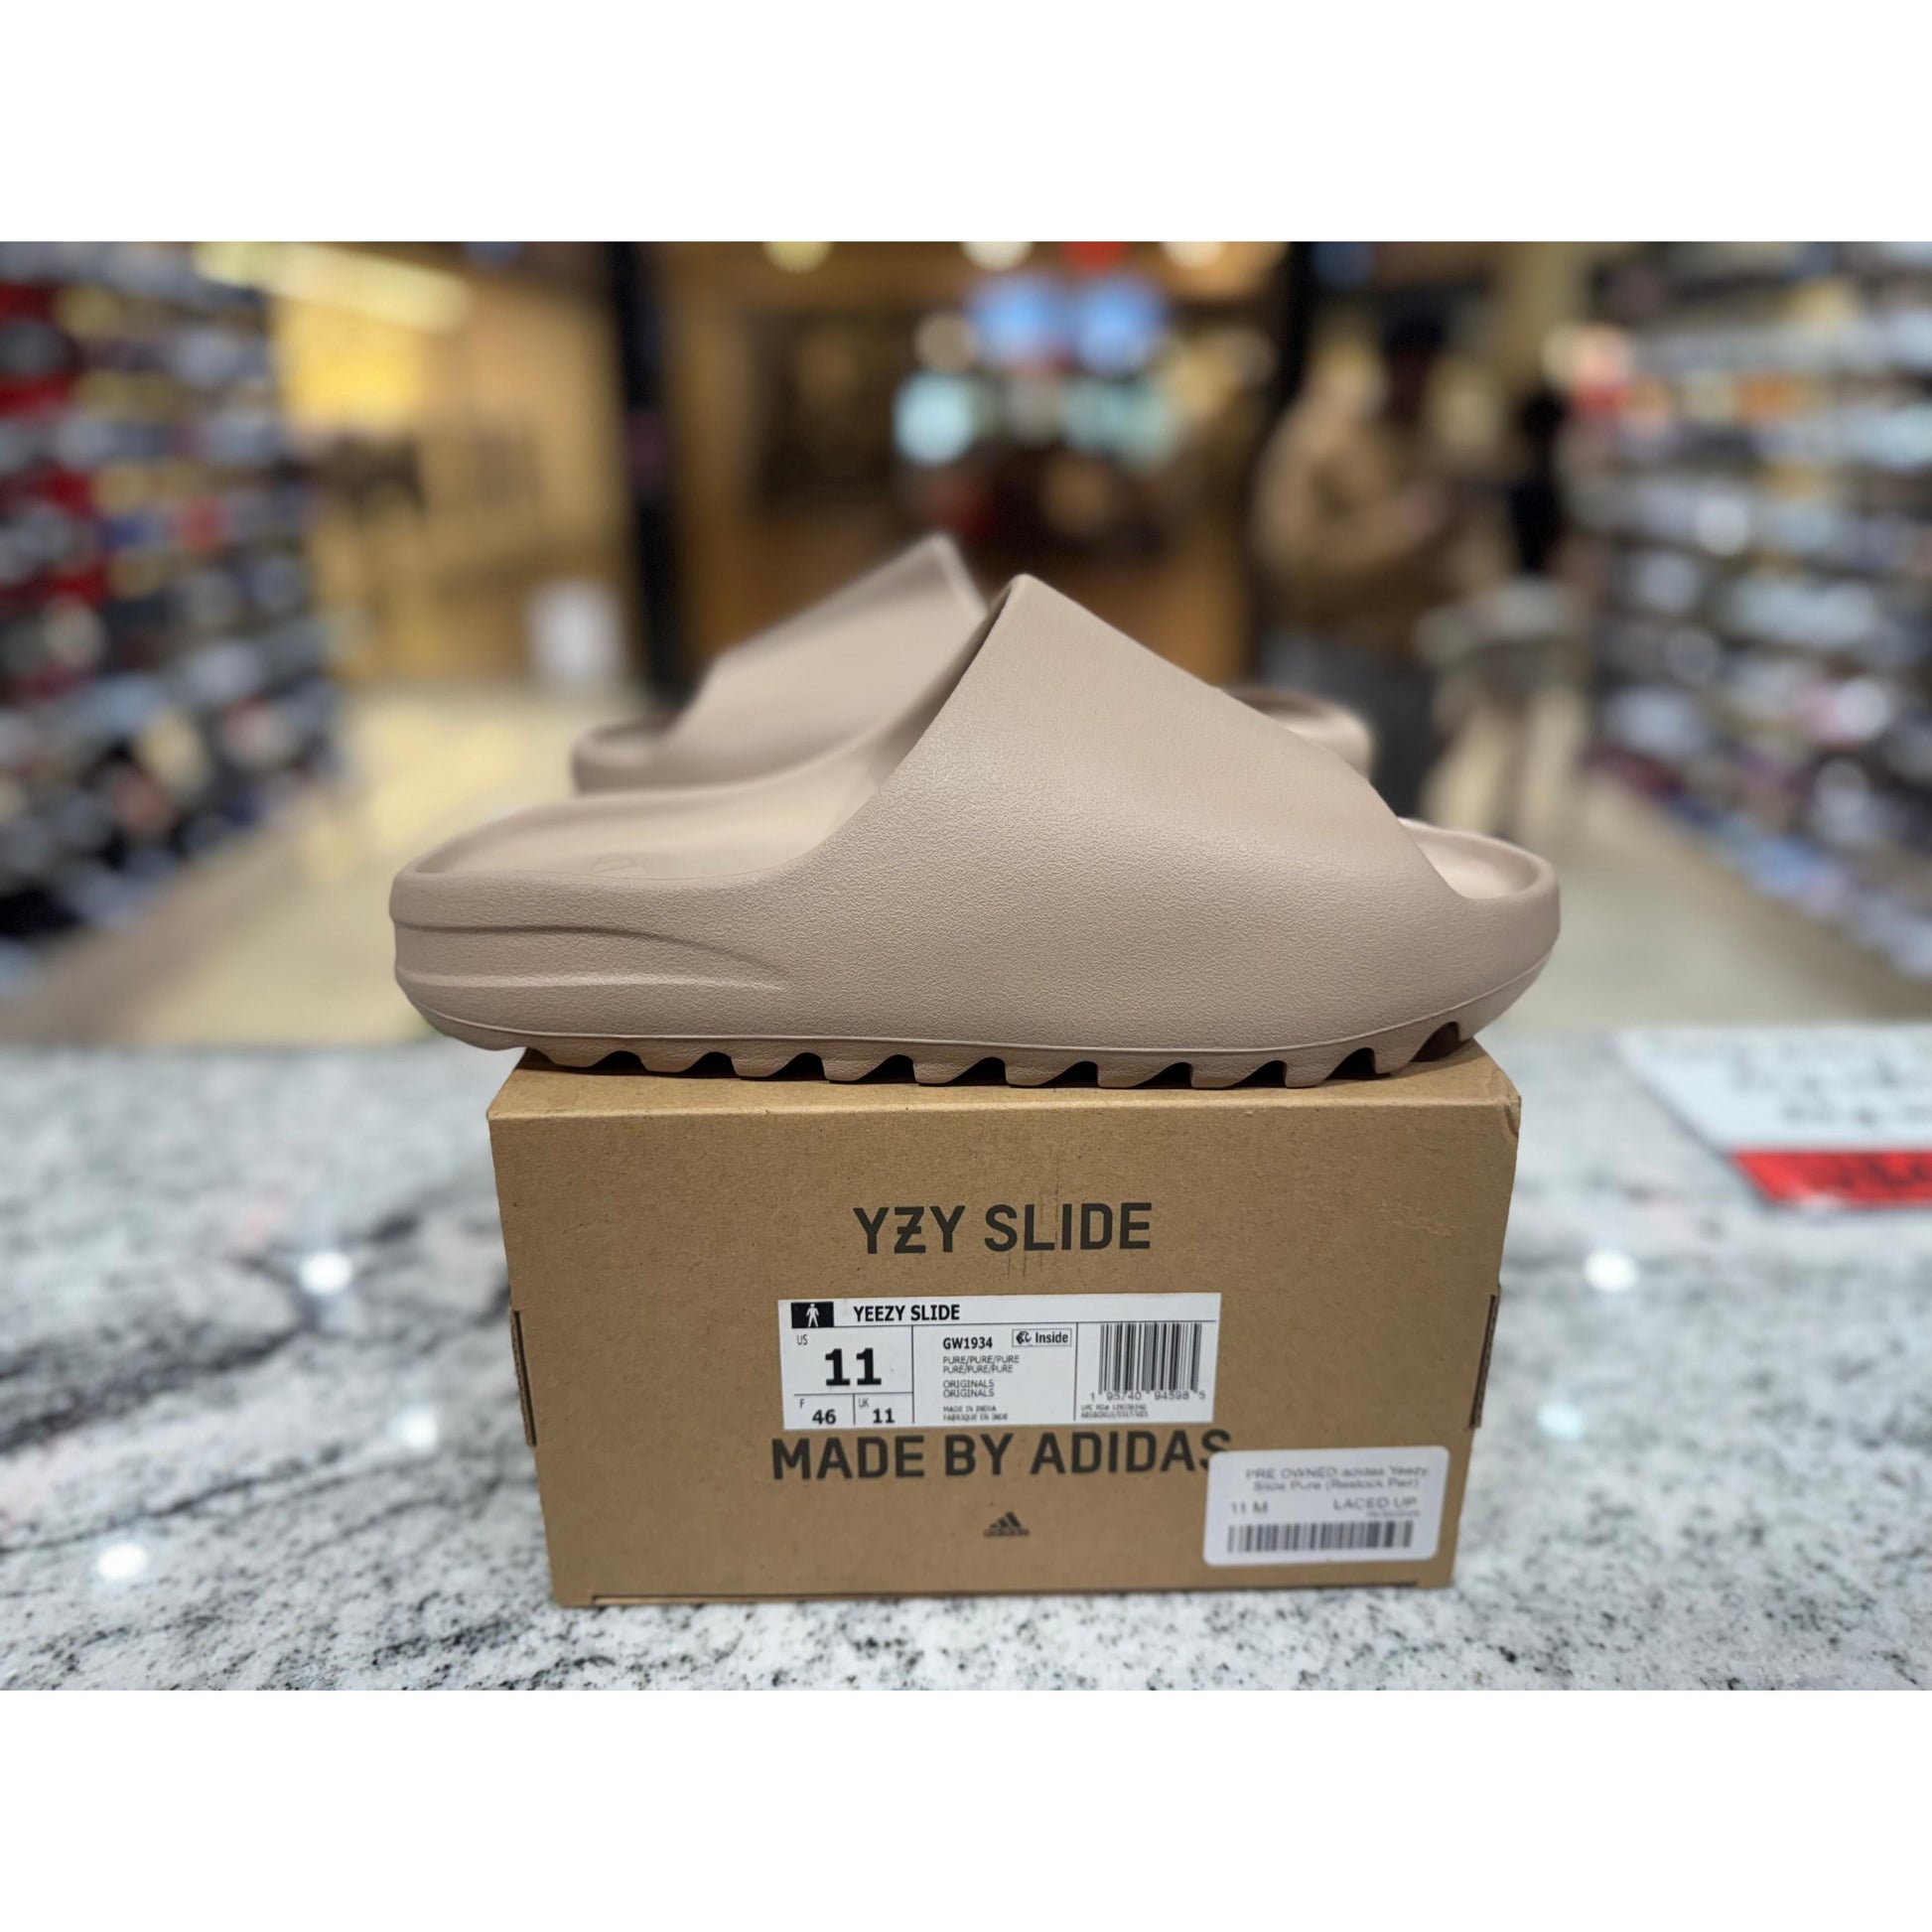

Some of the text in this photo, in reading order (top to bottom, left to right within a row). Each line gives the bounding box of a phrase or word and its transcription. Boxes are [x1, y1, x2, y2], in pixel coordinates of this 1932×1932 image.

[984, 1202, 1153, 1253] SLIDE
[853, 1304, 961, 1321] YEEZY SLIDE
[796, 1333, 808, 1346] US
[942, 1336, 994, 1349] GW1934
[1035, 1331, 1069, 1343] Inside
[942, 1354, 1021, 1365] PURE/PURE/PURE
[825, 1347, 882, 1387] 11
[942, 1378, 995, 1389] ORIGINALS
[942, 1388, 995, 1398] ORIGINALS
[1106, 1391, 1143, 1401] 95740
[1154, 1390, 1190, 1400] 94598
[798, 1399, 805, 1409] F
[858, 1398, 870, 1408] UK
[812, 1409, 837, 1425] 46
[873, 1408, 896, 1424] 11
[771, 1429, 1233, 1481] MADE BY ADIDAS
[1245, 1467, 1277, 1480] PRE
[1280, 1466, 1338, 1479] OWNED
[1252, 1501, 1269, 1514] M
[1332, 1495, 1418, 1510] LACED UP
